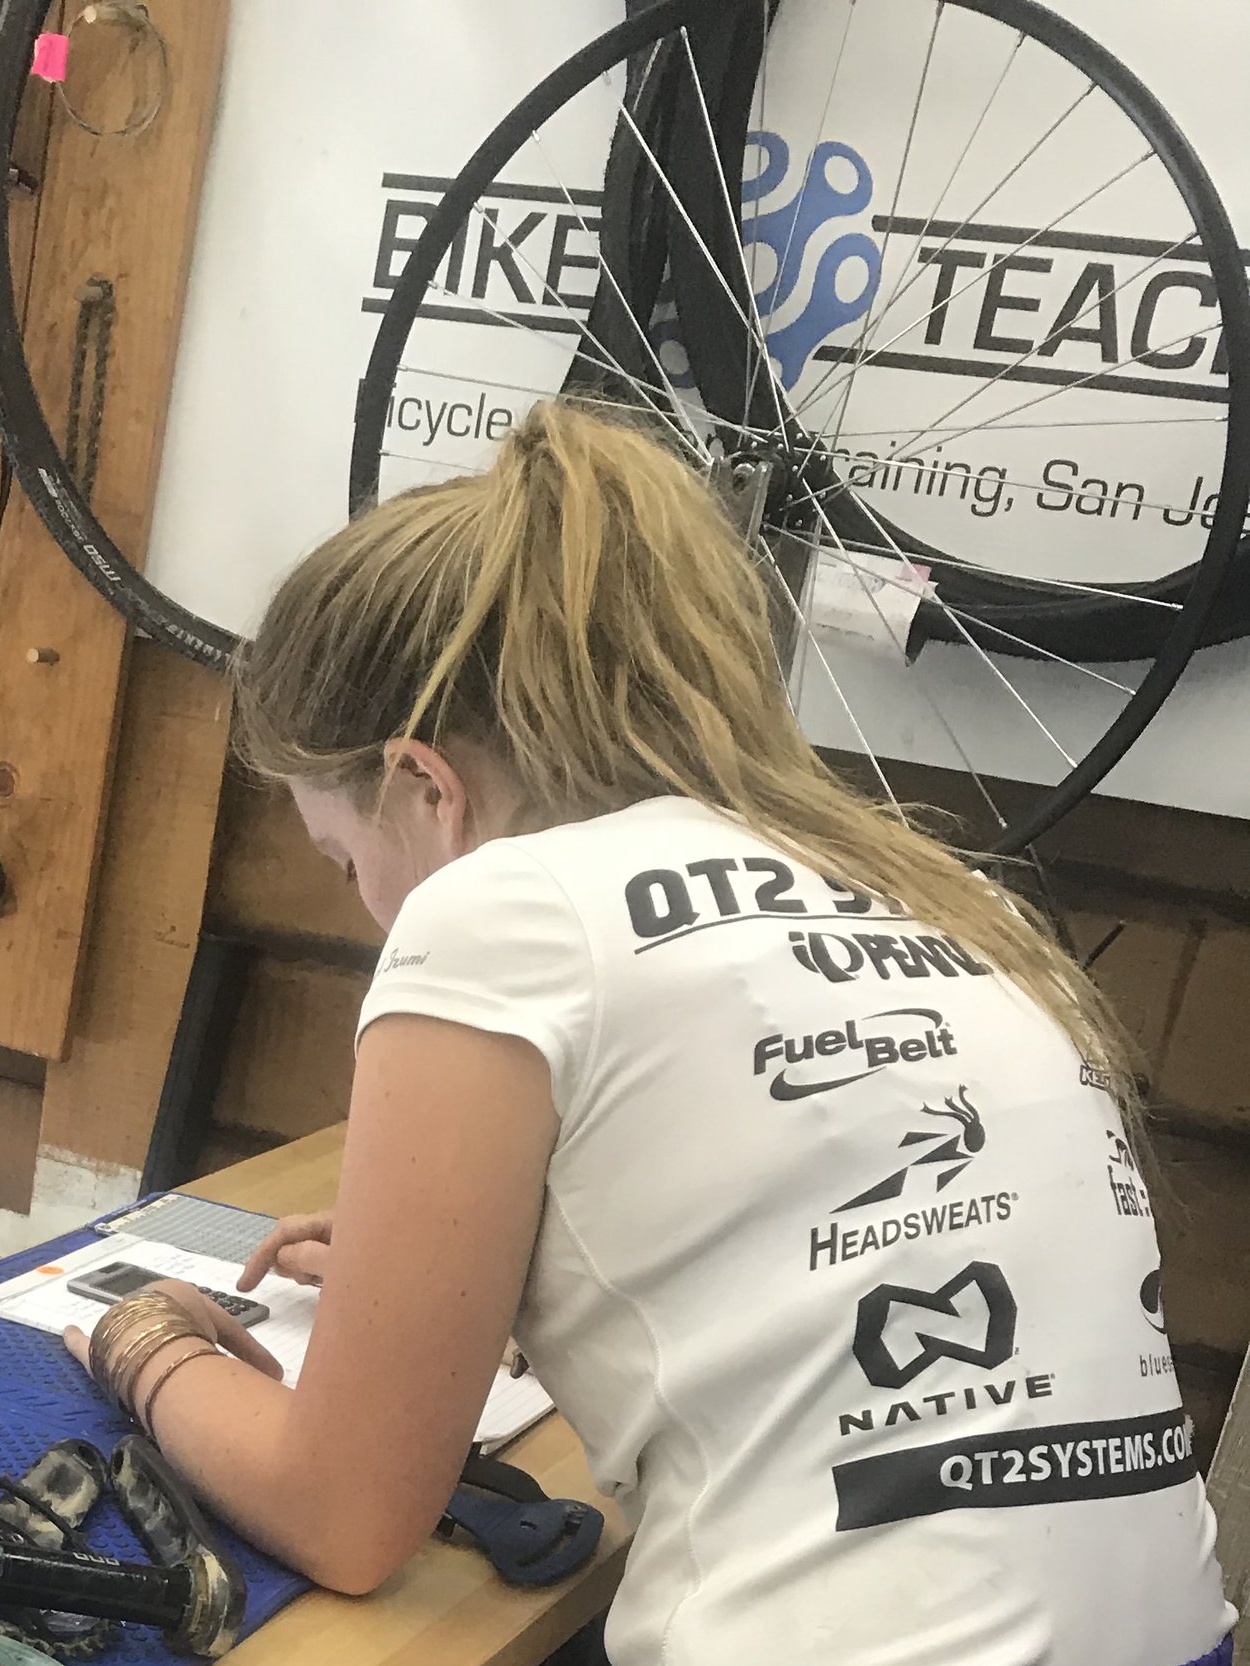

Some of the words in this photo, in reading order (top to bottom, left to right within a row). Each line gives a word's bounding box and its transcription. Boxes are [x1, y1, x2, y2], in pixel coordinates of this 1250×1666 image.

[373, 198, 603, 309] BIKE
[354, 378, 514, 447] icycle
[1036, 459, 1145, 522] San
[625, 857, 807, 939] QT2
[839, 1374, 1053, 1436] NATIVE
